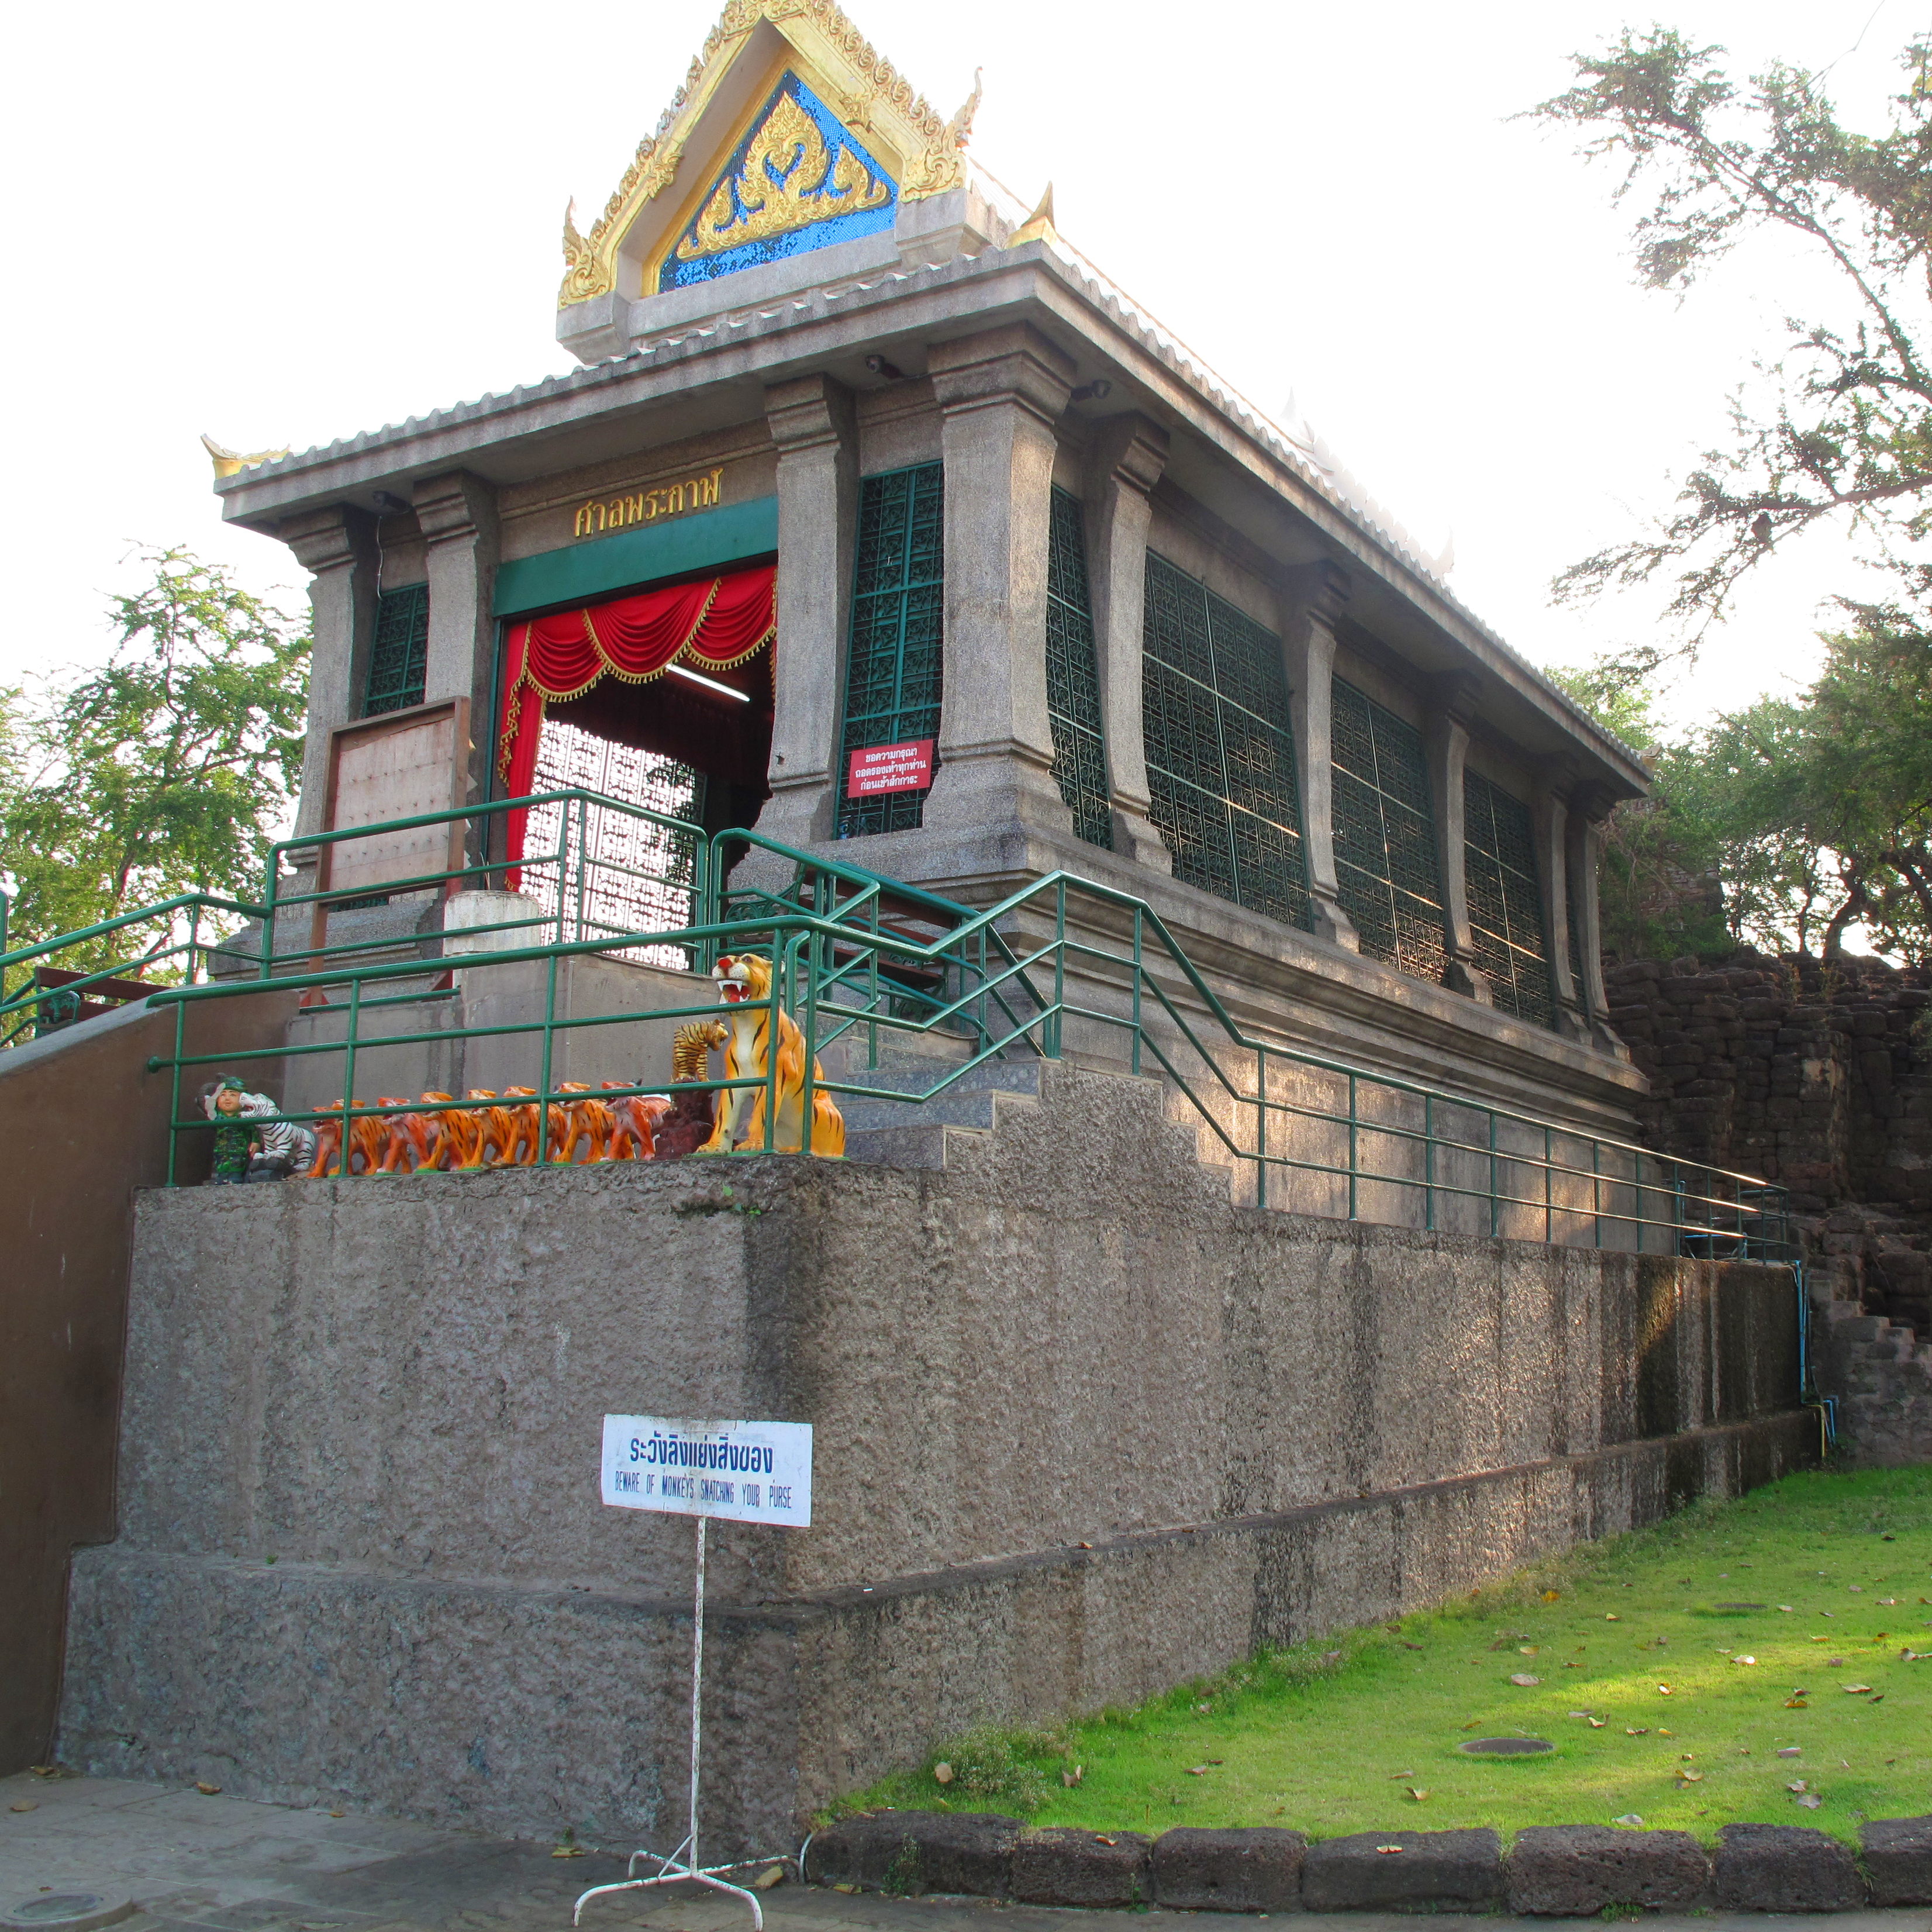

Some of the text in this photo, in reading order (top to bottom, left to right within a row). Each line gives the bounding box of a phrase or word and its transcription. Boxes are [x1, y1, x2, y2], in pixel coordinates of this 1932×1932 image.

[575, 468, 724, 537] ศาลพระกาฬ
[855, 759, 926, 778] ถอดรองเท้าทุกท่าน
[865, 747, 917, 763] ขอความกรุณา
[861, 775, 918, 791] ก่อนเข้าสักการะ
[630, 1430, 774, 1474] ระวังลิงแย่งสิ่งของ
[615, 1470, 792, 1509] BEWARE OF MONKEYS SNATCHING YOUR PURSE
